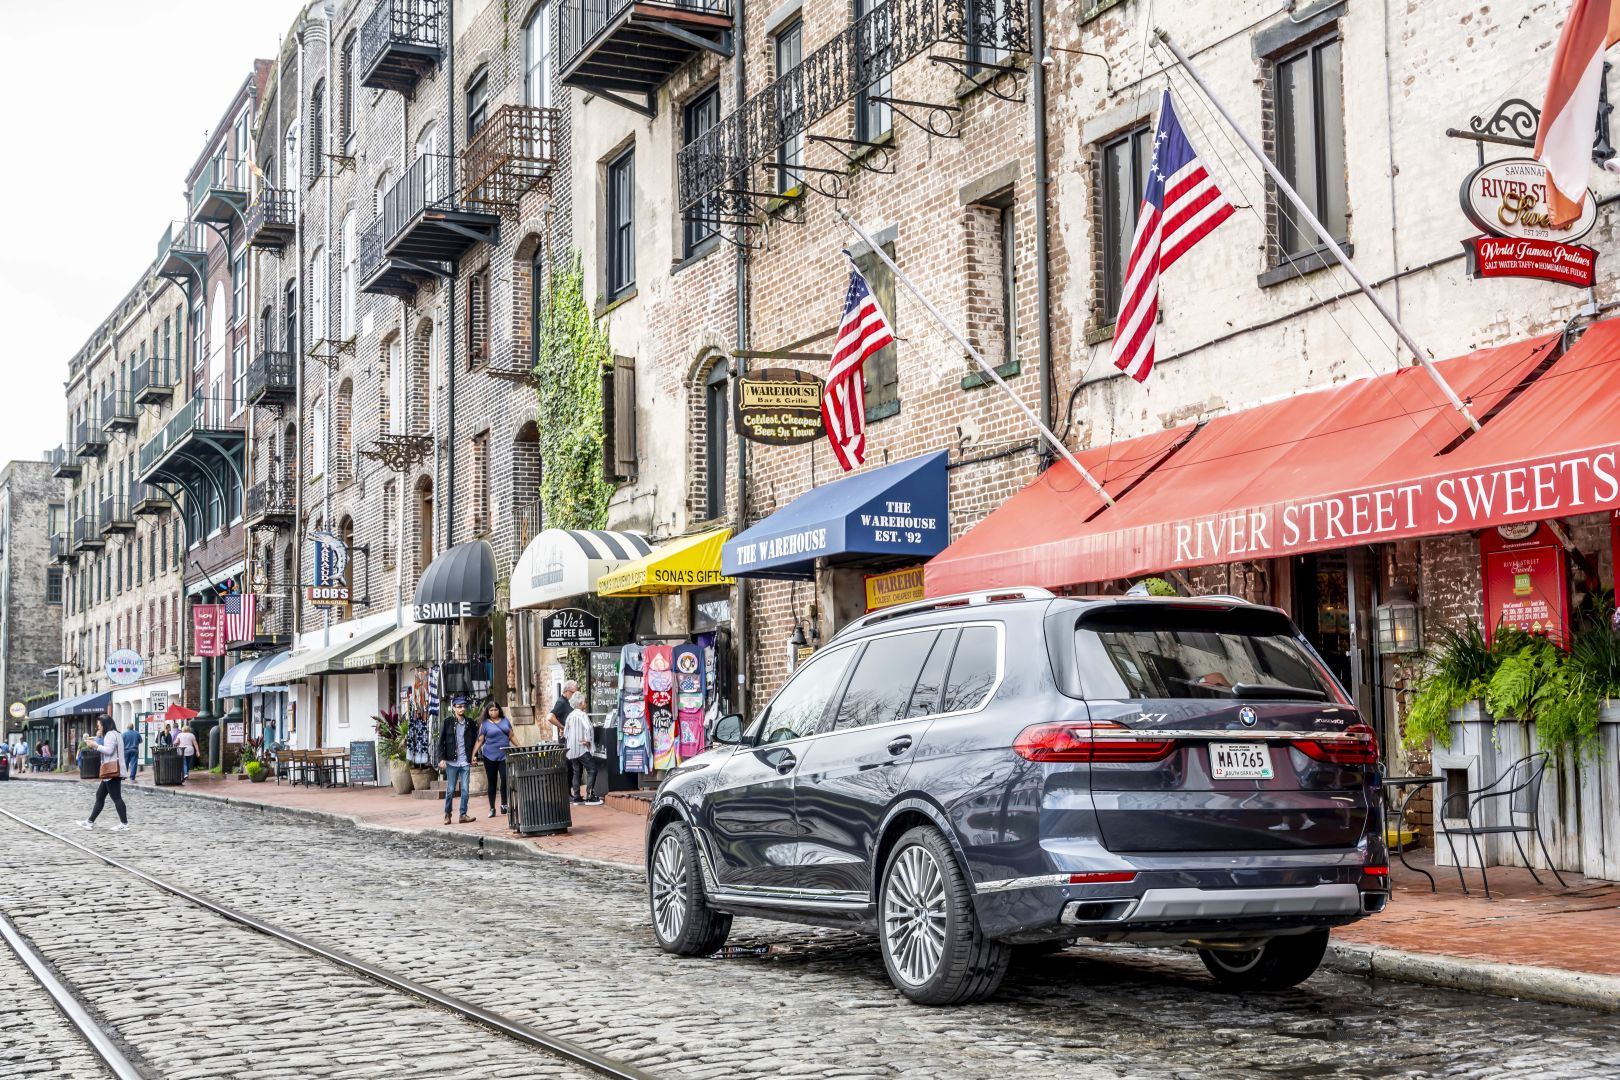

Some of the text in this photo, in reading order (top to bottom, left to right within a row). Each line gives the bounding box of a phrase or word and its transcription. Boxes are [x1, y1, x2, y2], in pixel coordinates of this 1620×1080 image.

[1481, 178, 1528, 199] RIVER
[1536, 229, 1549, 237] 1973
[1481, 242, 1590, 267] World Famous Pralines
[1485, 261, 1588, 279] SALT WATER TAFFY HOMEMADE FUDGE
[750, 386, 818, 397] WAREHOUSE
[743, 414, 822, 427] Coldest, Cheapest
[753, 425, 776, 436] Beer
[791, 426, 815, 437] Town
[886, 501, 911, 513] THE
[1174, 452, 1619, 562] RIVER STREET SWEETS
[861, 515, 936, 529] WAREHOUSE
[875, 530, 922, 543] EST. '92
[737, 528, 826, 565] THE WAREHOUSE
[1520, 558, 1539, 566] STREET
[655, 569, 694, 582] SONA'S
[876, 570, 924, 594] WAREHOU
[312, 588, 349, 599] BOB'S
[422, 602, 472, 619] SMILE
[560, 611, 585, 628] Vic's
[550, 629, 592, 637] COFFEE BAR
[154, 703, 165, 711] 15
[1136, 713, 1168, 722] X7
[1217, 751, 1264, 767] MA1265
